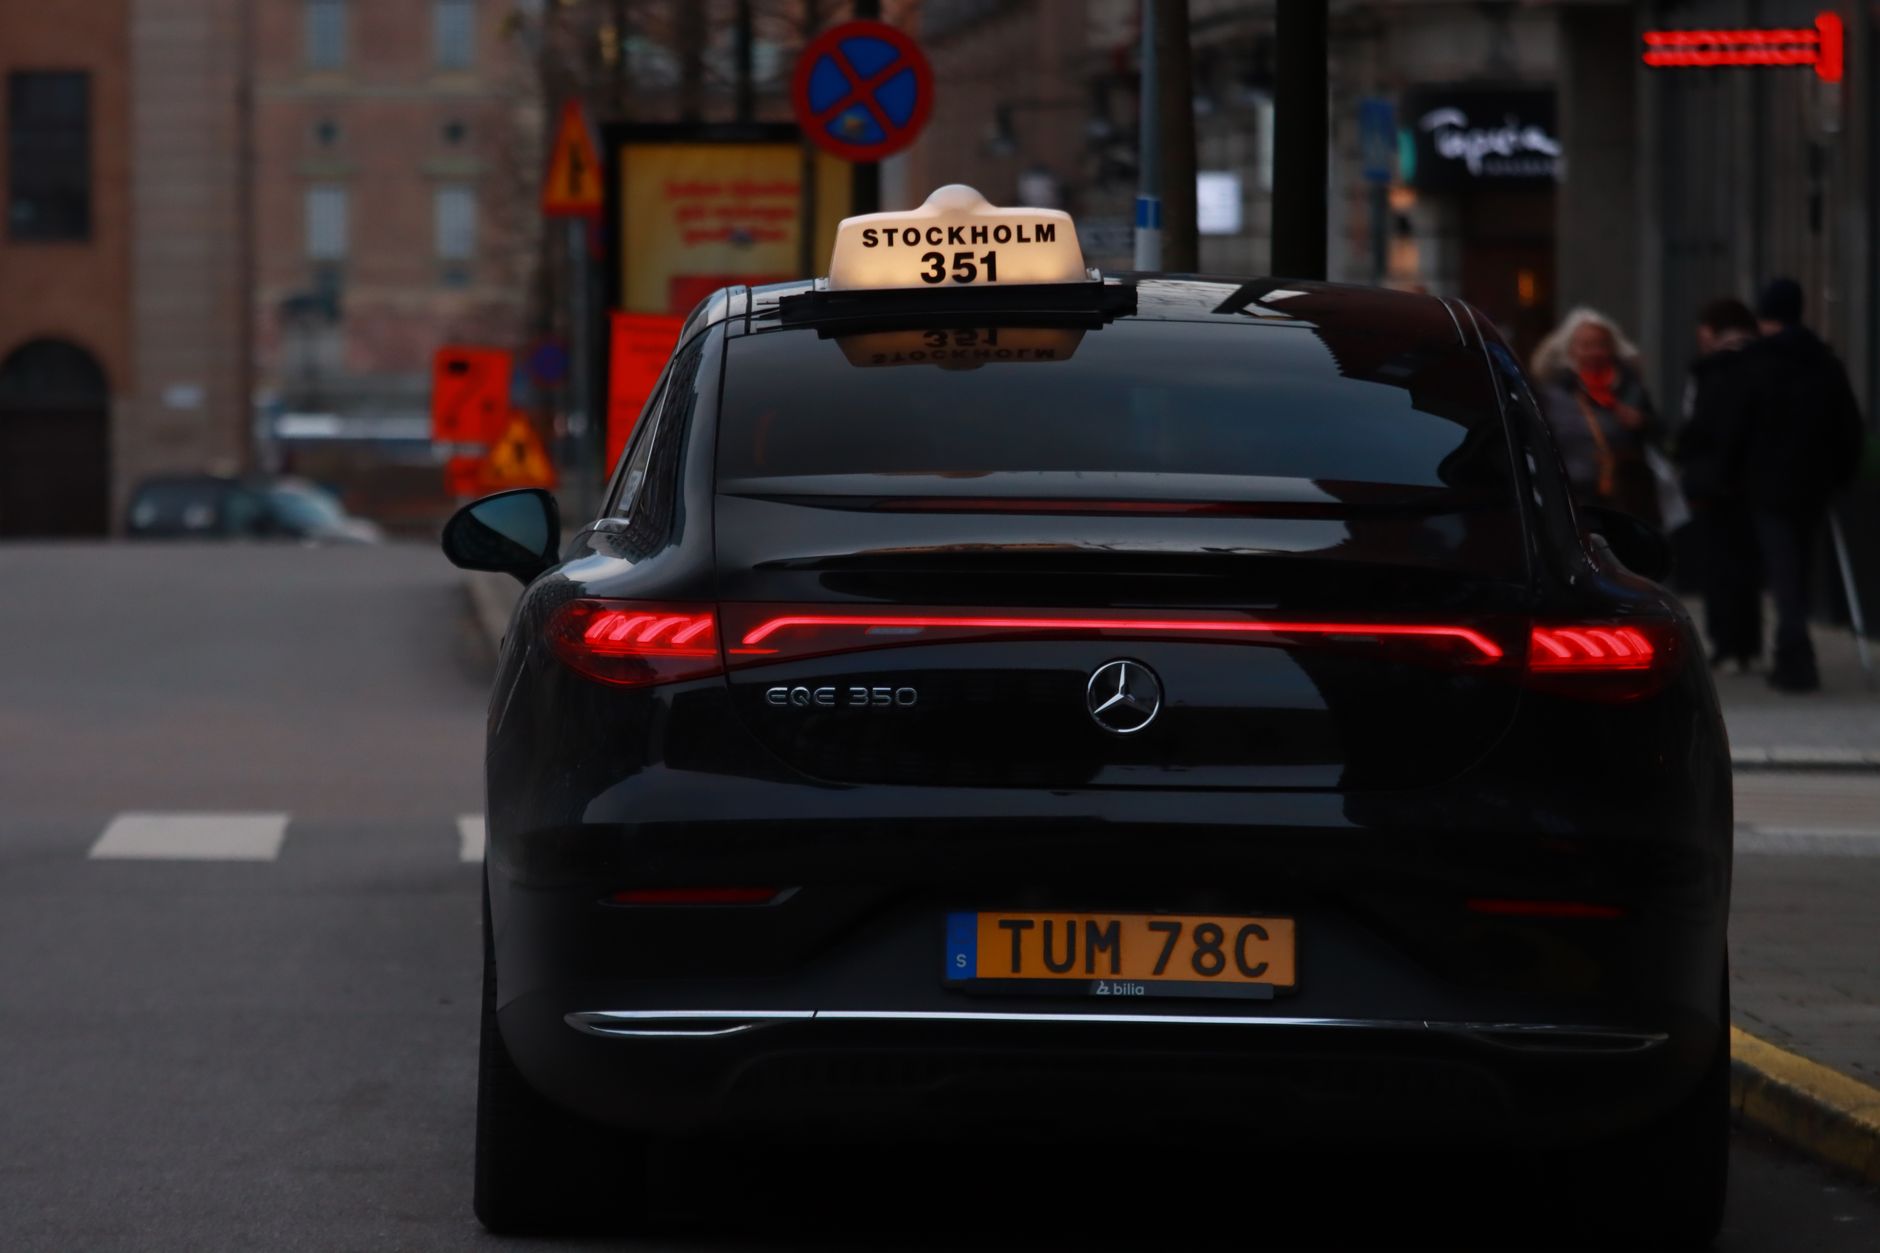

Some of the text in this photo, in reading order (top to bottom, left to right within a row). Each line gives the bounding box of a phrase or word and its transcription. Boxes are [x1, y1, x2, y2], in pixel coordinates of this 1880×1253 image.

[862, 223, 1056, 248] STOCKHOLM
[920, 251, 998, 284] 351
[766, 686, 918, 706] EQE 350
[998, 919, 1270, 979] TUM 78C
[955, 953, 967, 968] S
[1113, 982, 1145, 995] bilia
